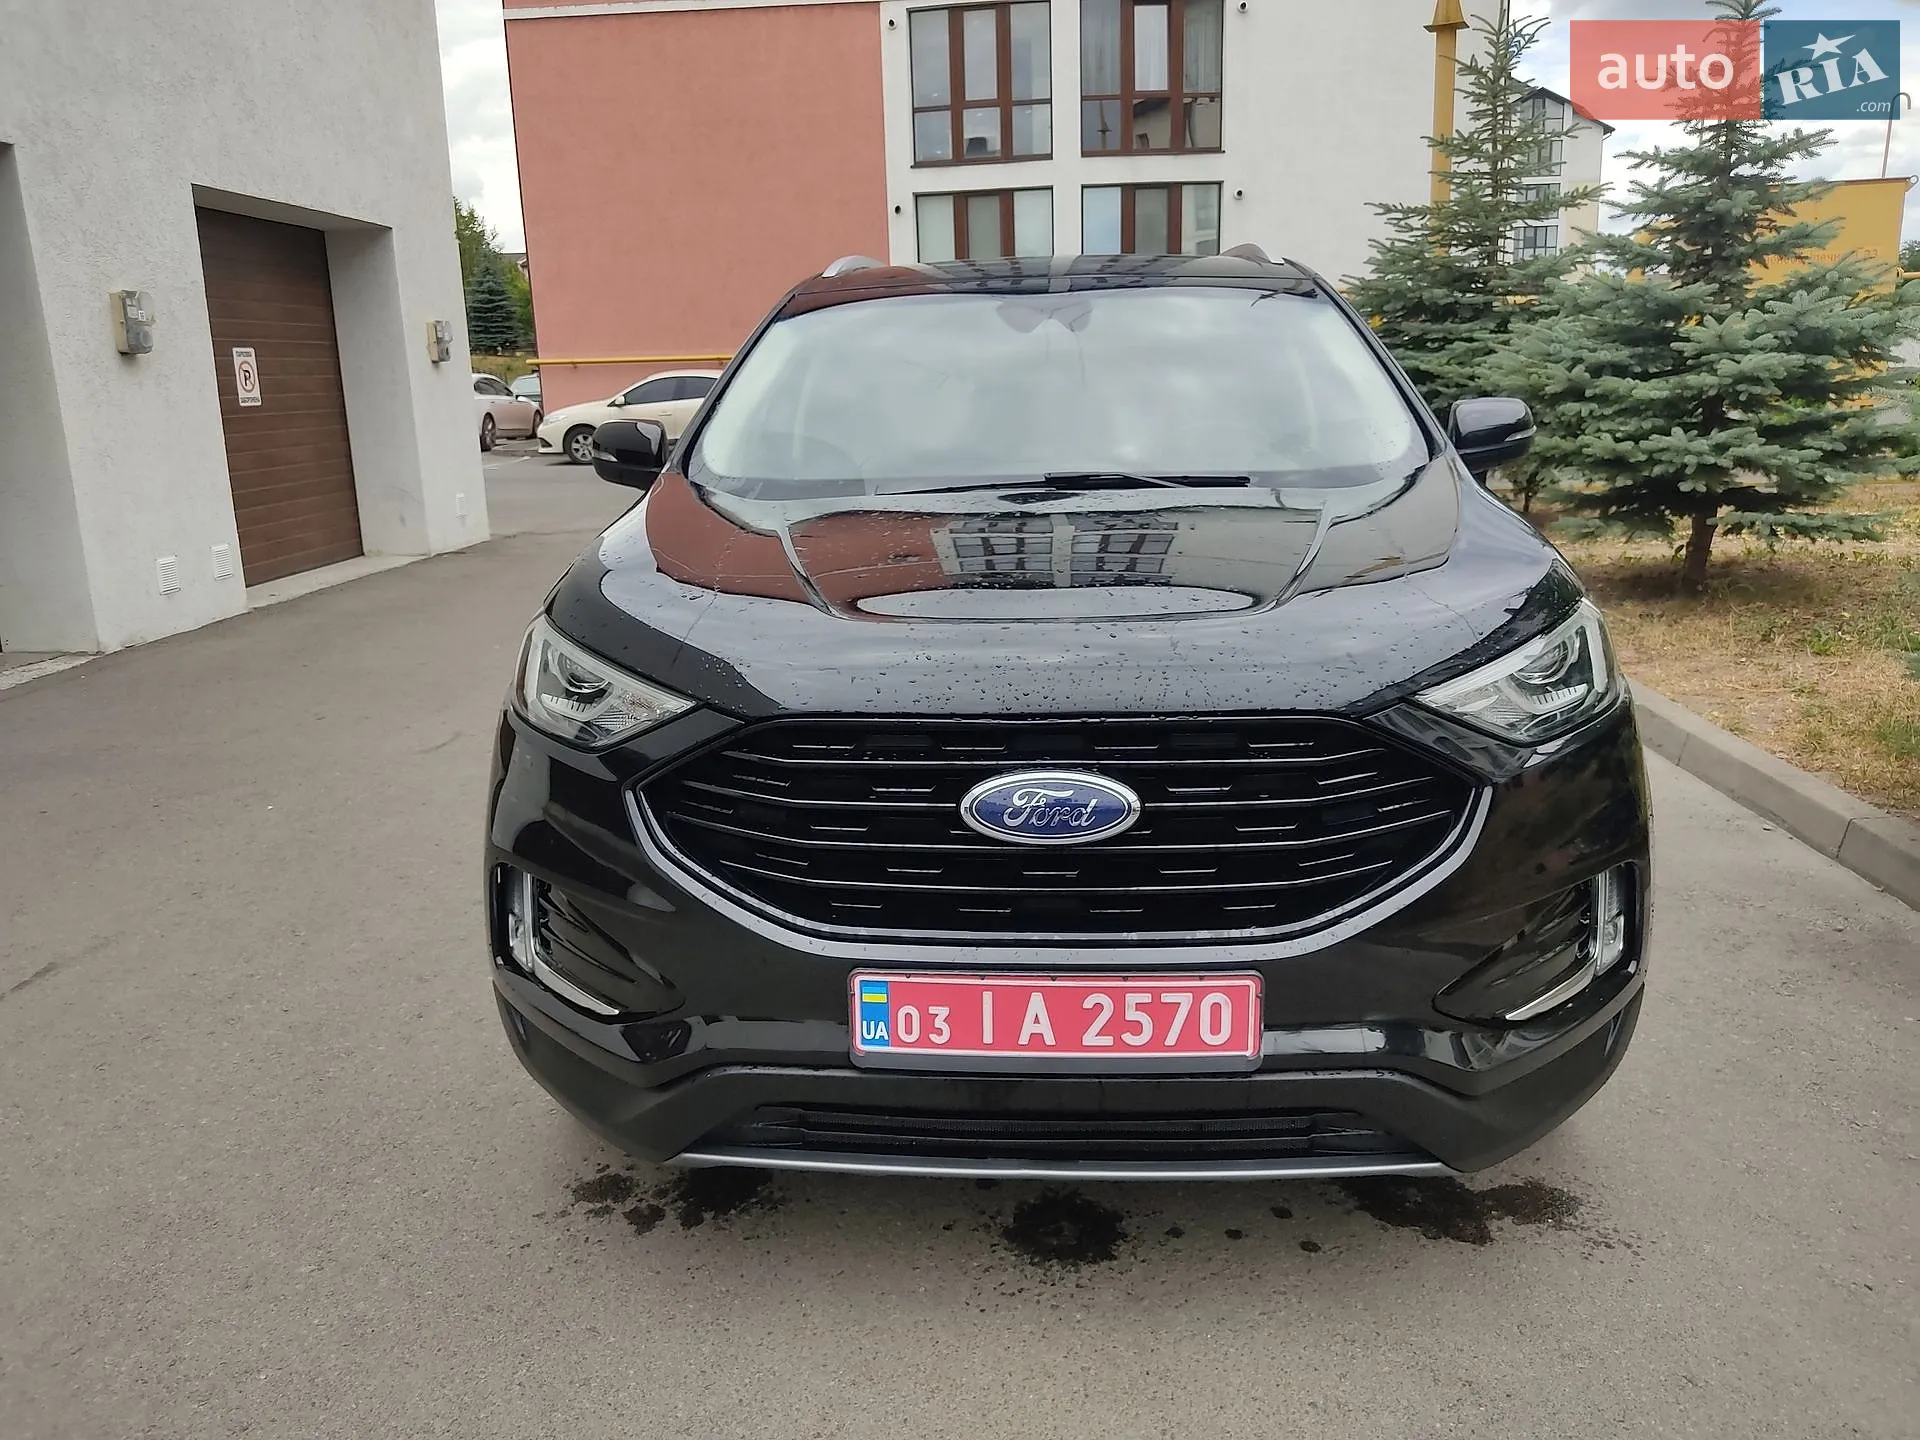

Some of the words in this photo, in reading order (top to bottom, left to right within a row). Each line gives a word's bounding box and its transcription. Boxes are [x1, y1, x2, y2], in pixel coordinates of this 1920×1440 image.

[1003, 788, 1098, 827] Ford
[862, 1020, 888, 1040] UA
[896, 1005, 952, 1044] 03
[1081, 992, 1232, 1047] 2570
